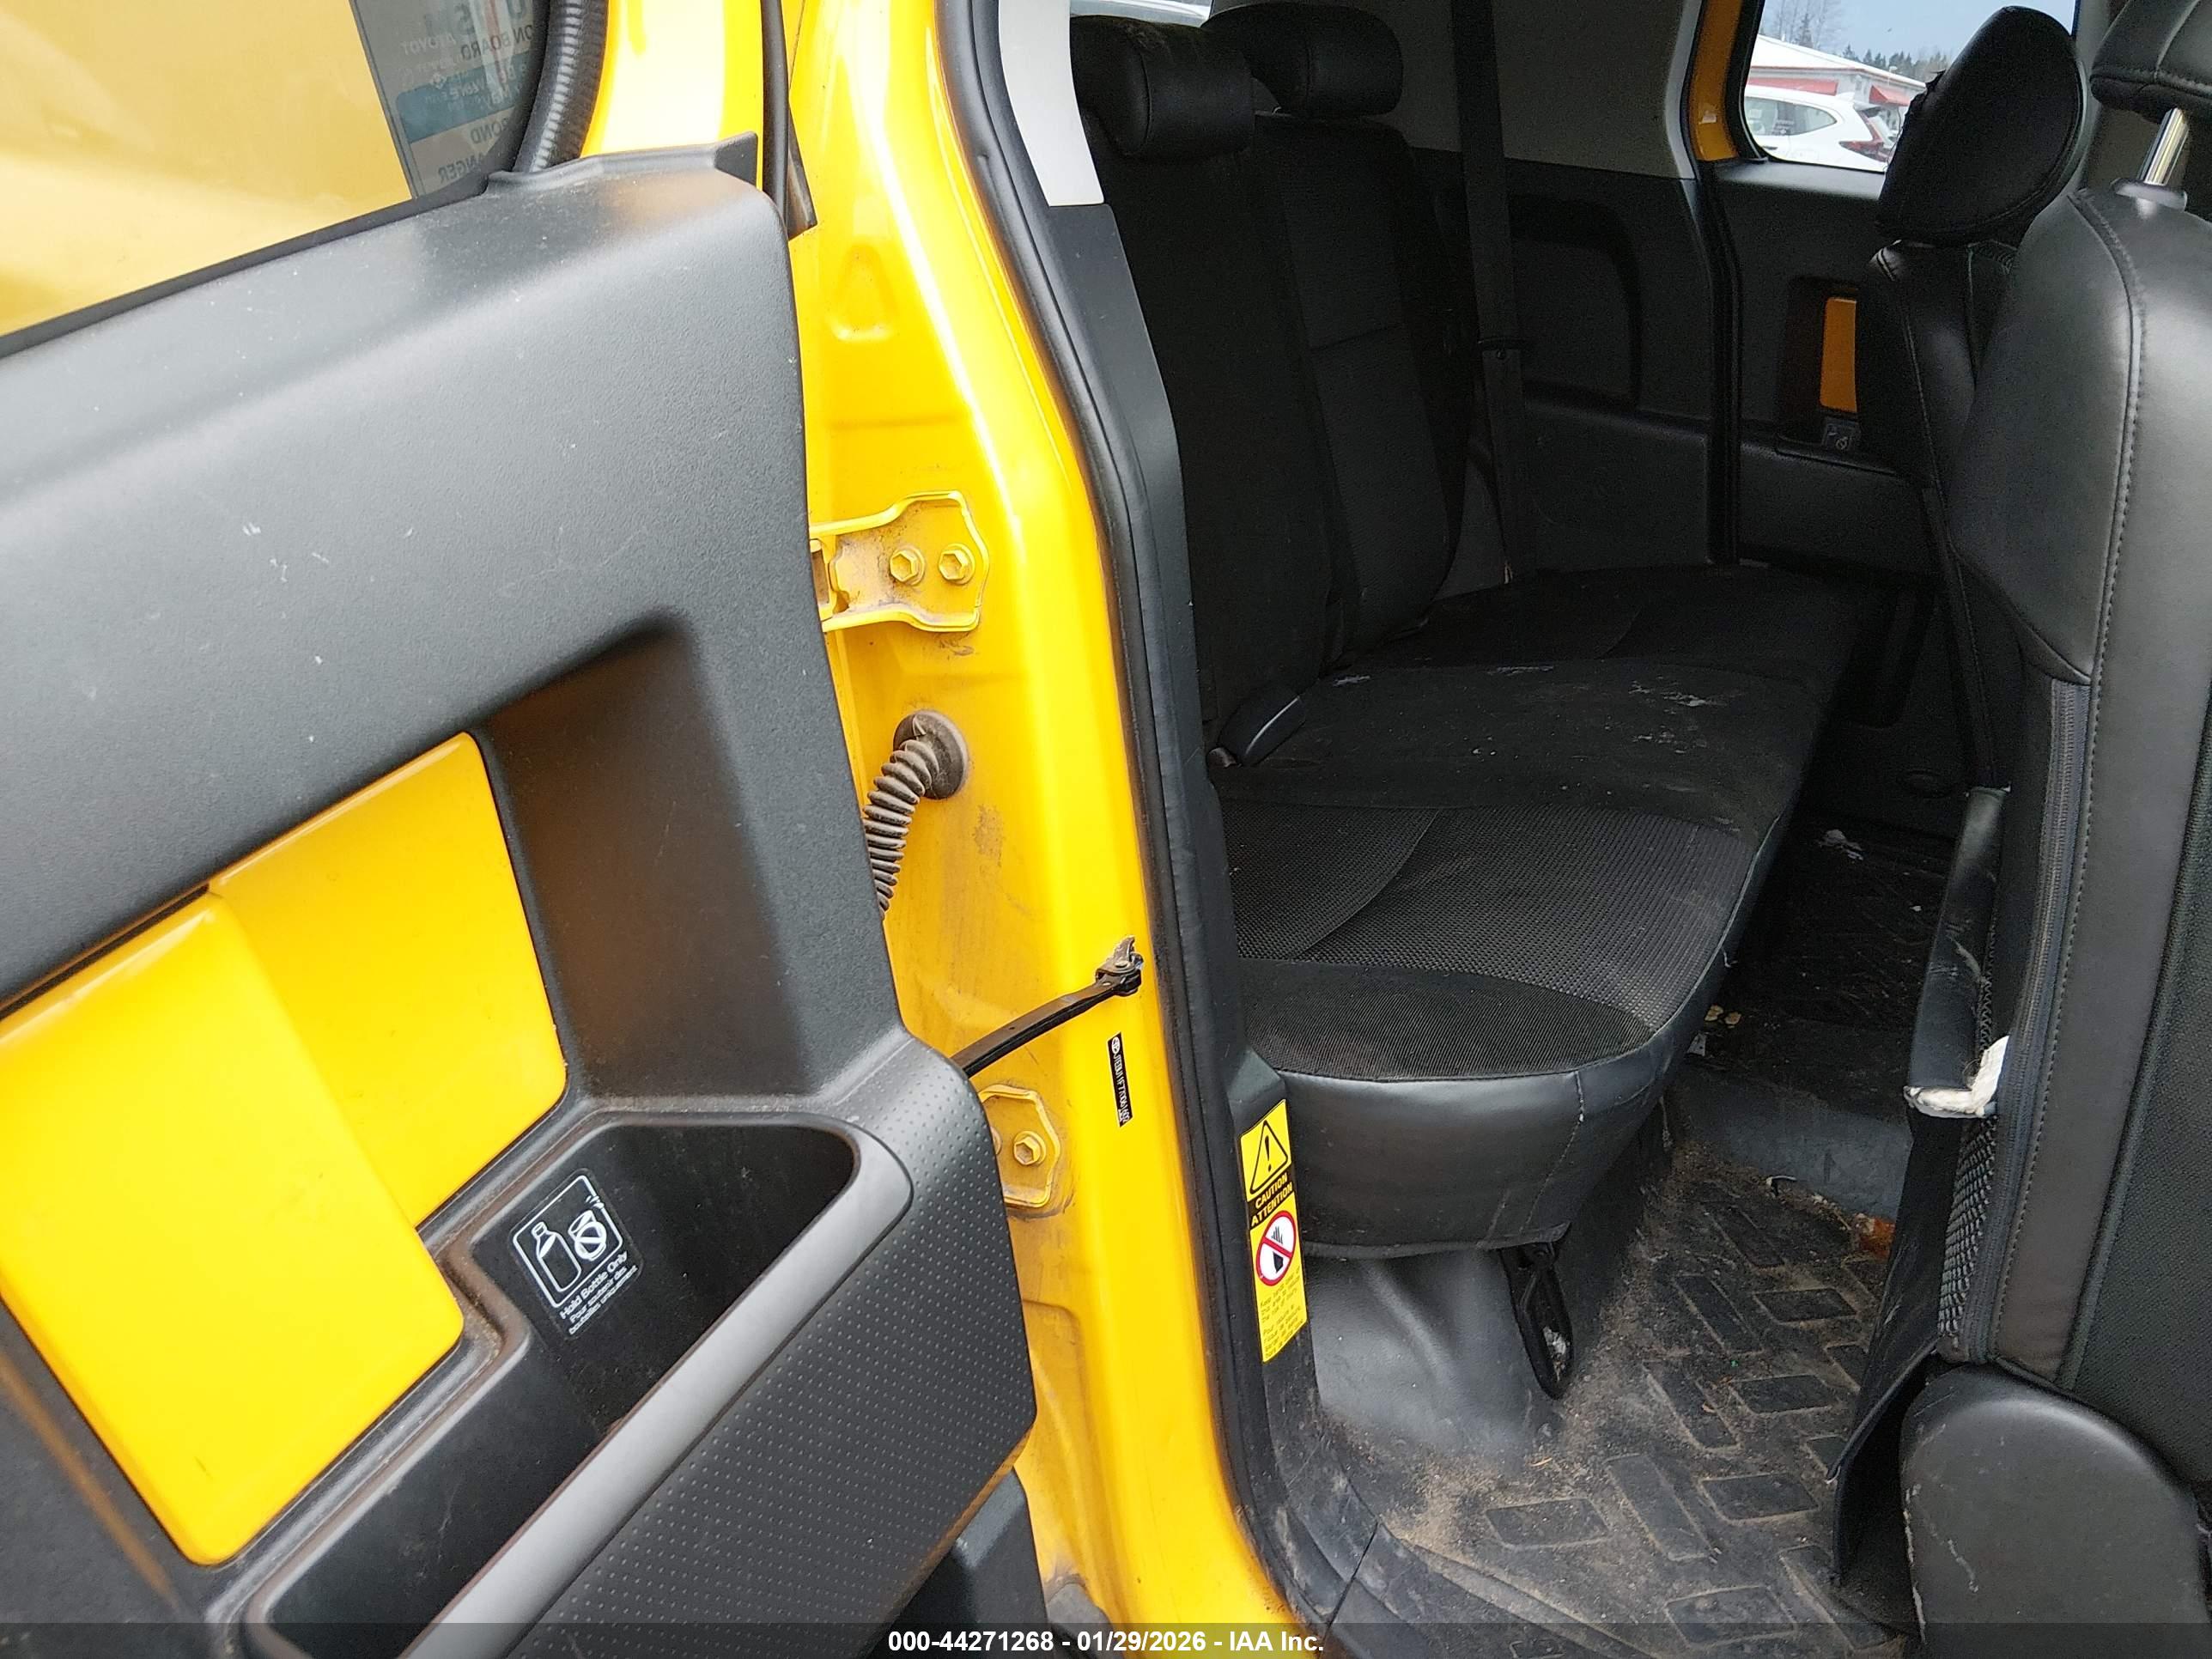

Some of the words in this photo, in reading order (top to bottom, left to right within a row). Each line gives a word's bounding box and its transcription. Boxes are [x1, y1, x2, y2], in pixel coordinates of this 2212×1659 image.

[1250, 1182, 1293, 1227] ATTENTION
[1255, 1171, 1289, 1209] CAUTION
[559, 1294, 582, 1319] Hold
[580, 1270, 610, 1297] Bottle
[607, 1250, 629, 1275] Only
[569, 1304, 589, 1323] Pour
